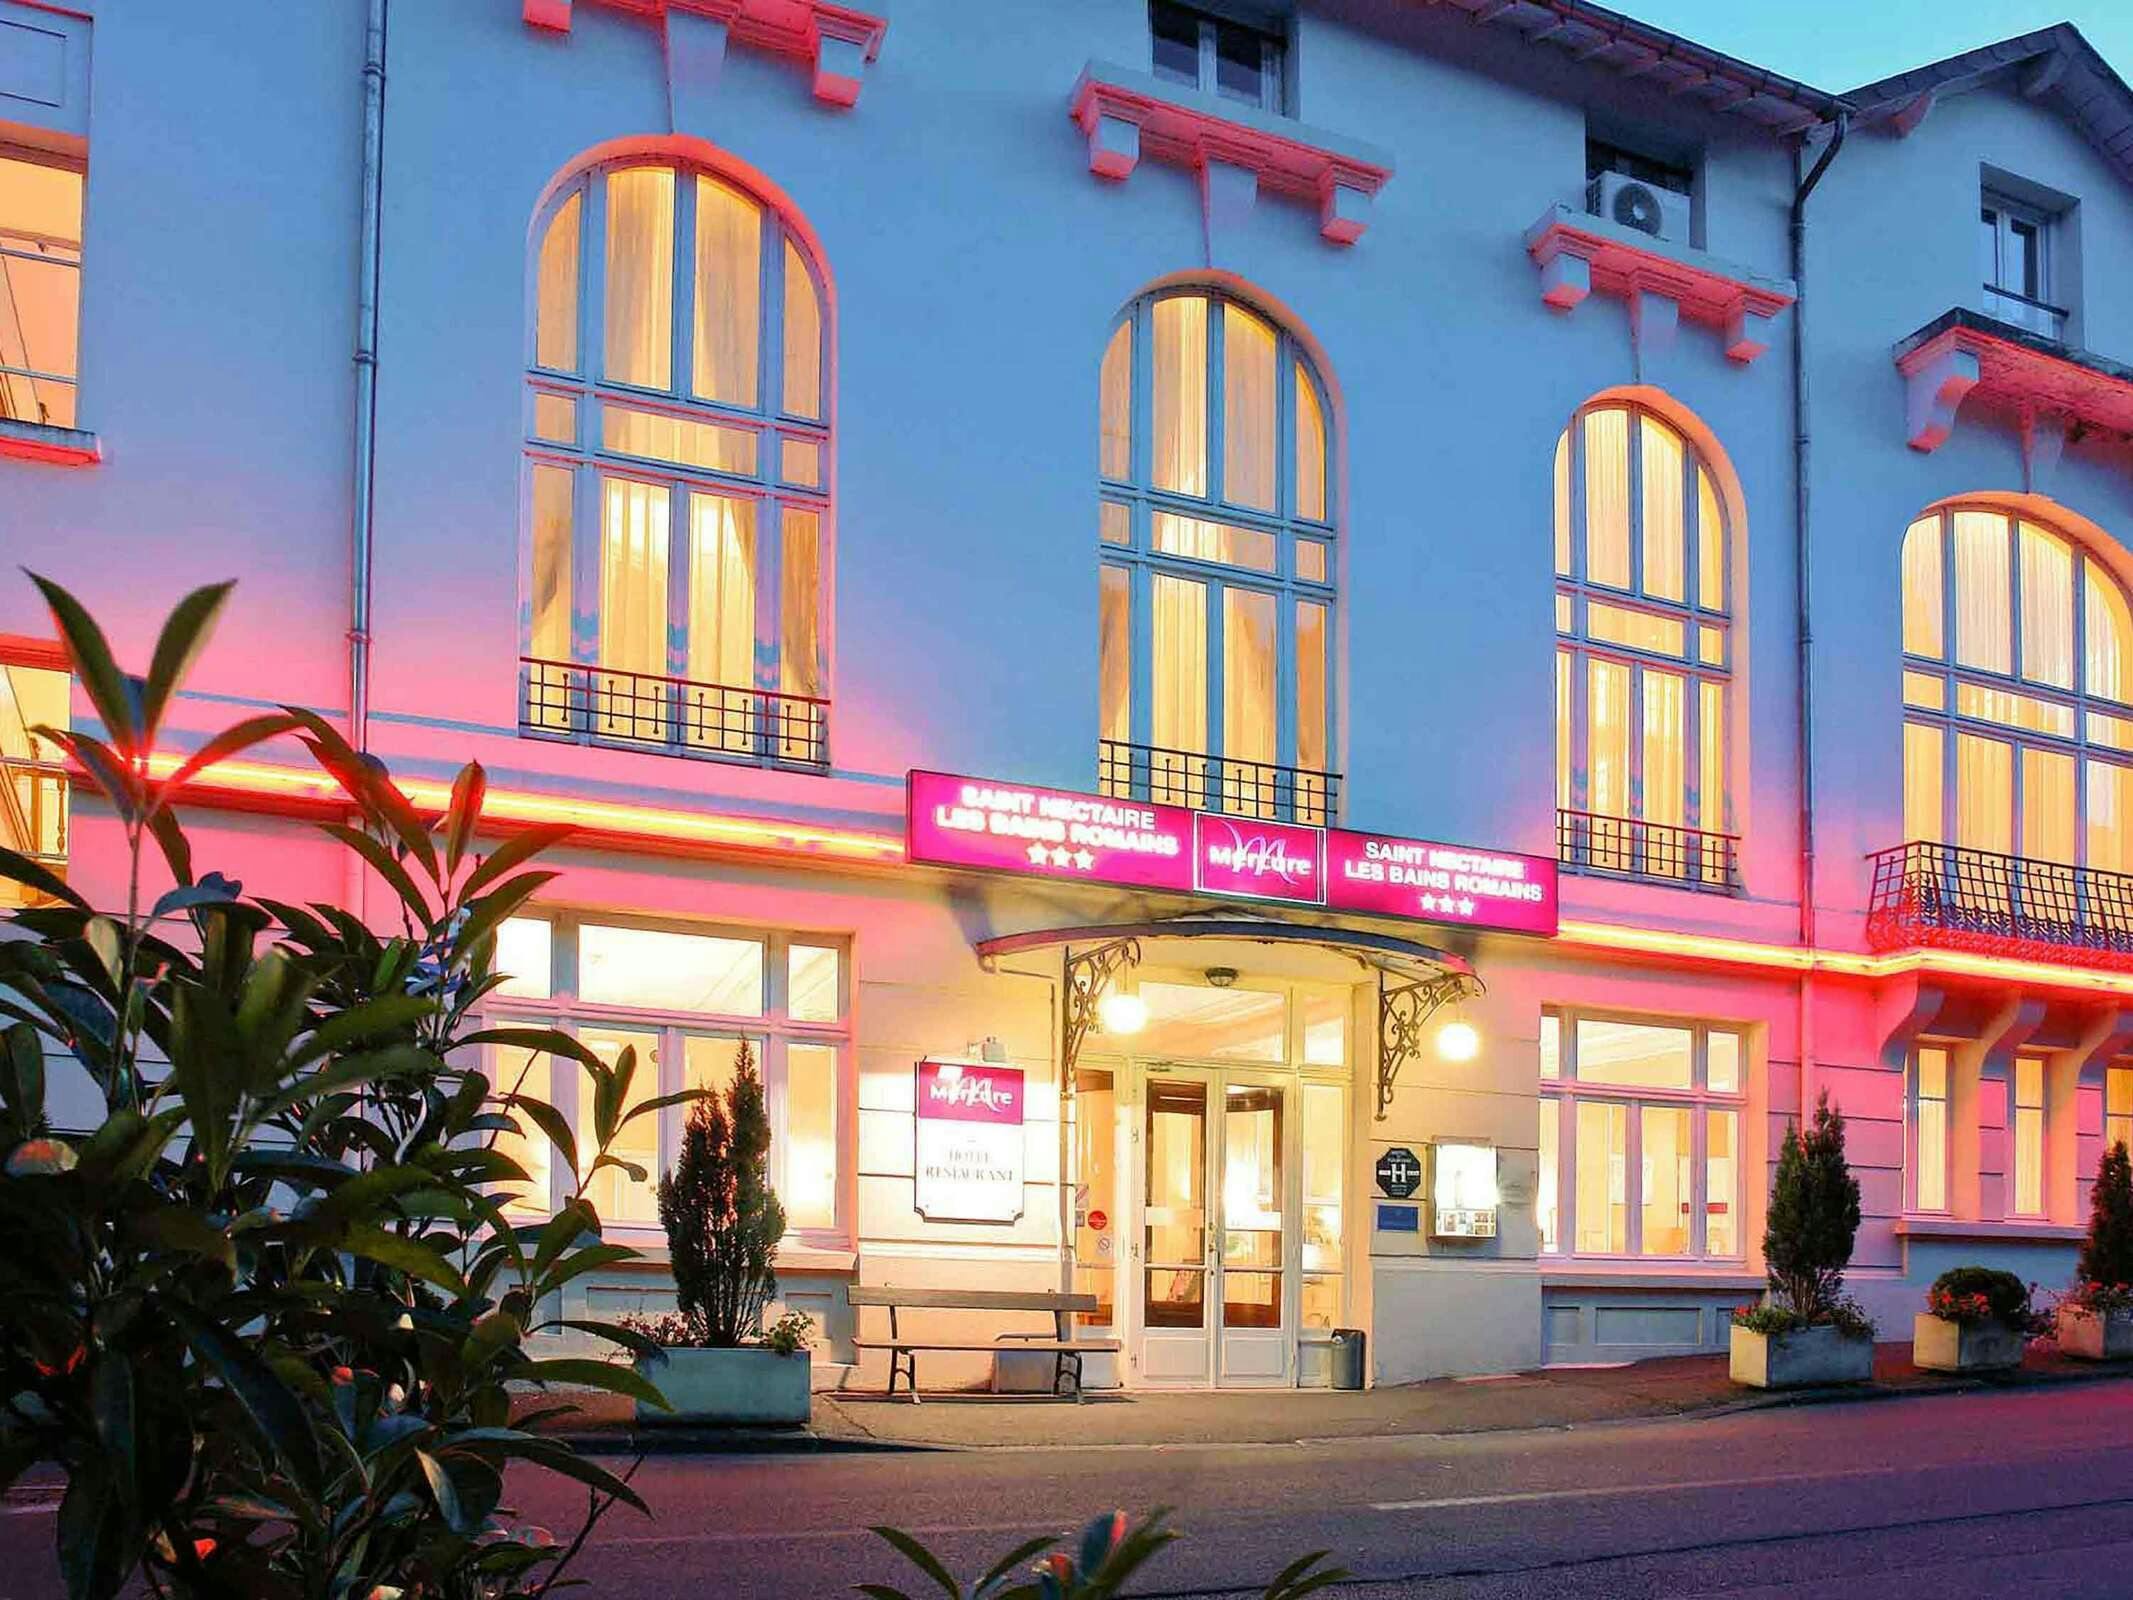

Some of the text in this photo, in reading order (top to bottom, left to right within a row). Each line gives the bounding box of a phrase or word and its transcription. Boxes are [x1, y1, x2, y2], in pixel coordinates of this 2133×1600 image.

[1366, 841, 1426, 865] SAINT
[1345, 860, 1542, 901] LES BAINS ROMAINS
[925, 1164, 1013, 1182] RESTAURANT
[1391, 1163, 1407, 1184] H
